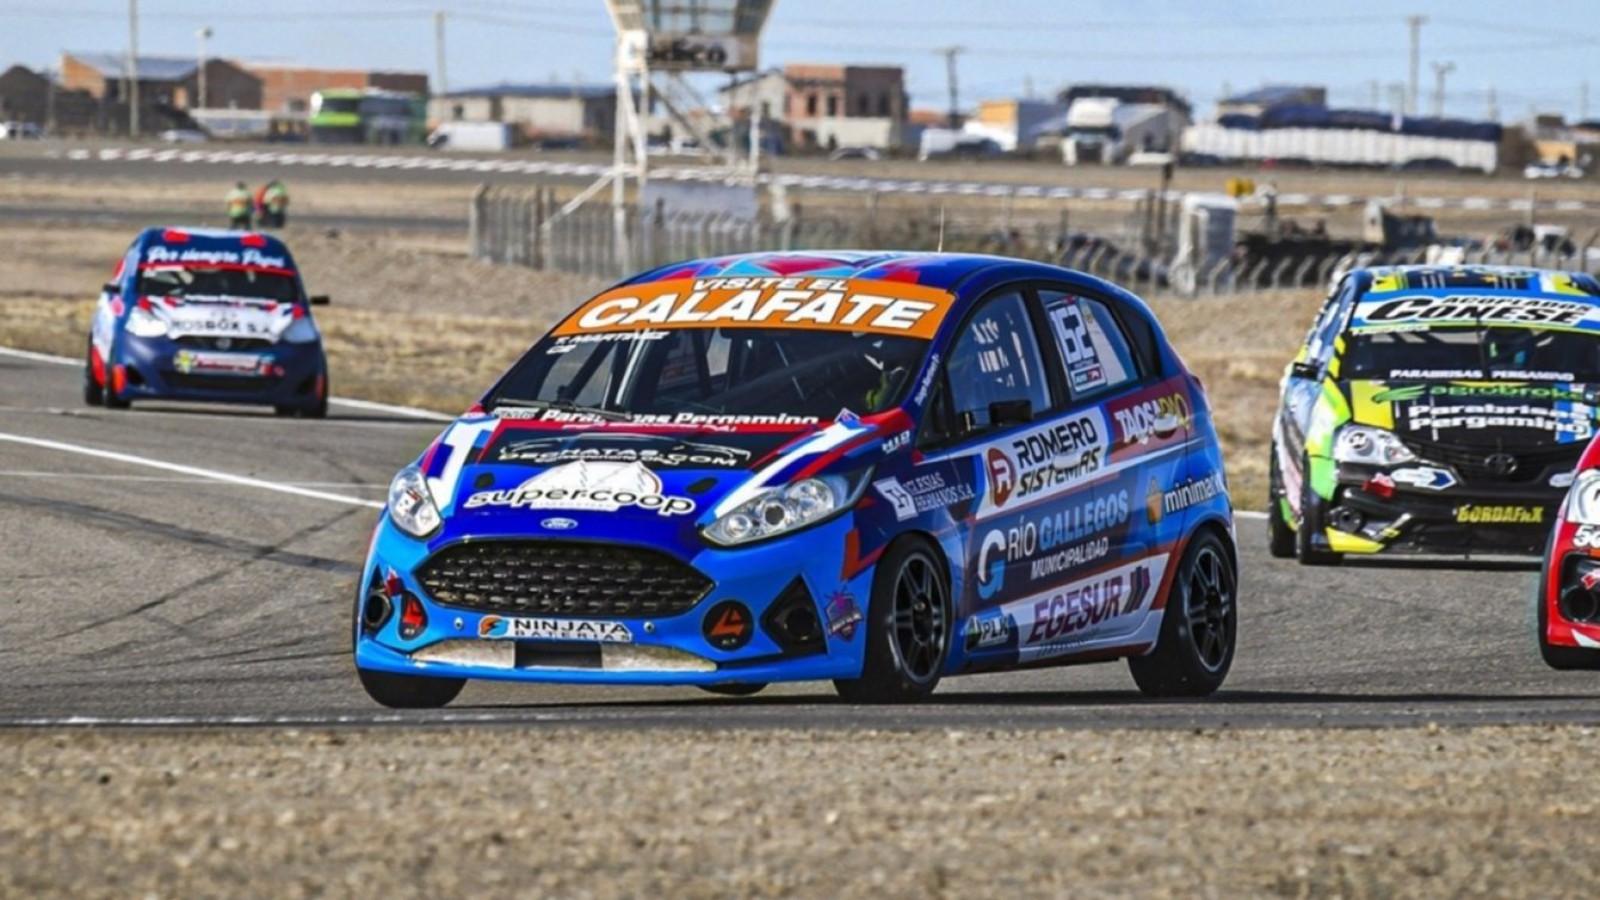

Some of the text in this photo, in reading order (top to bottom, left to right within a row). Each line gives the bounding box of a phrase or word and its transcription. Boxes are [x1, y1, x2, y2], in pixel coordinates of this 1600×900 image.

[694, 278, 849, 291] VISITE EL
[578, 289, 937, 329] CALAFATE
[1365, 298, 1582, 324] CONESE
[1390, 369, 1575, 381] PARABRISAS PERGAMINO
[673, 412, 819, 425] Pergamino
[1408, 403, 1589, 420] Parabrisas
[1409, 416, 1592, 438] Pergamino
[1012, 416, 1099, 468] ROMERO
[1016, 447, 1100, 498] SISTEMAS
[463, 488, 697, 516] supercoop
[1007, 490, 1130, 562] RÍO GALLEGOS
[1031, 536, 1109, 580] MUNICIPALIDAD
[1027, 575, 1124, 644] EGESUR
[514, 620, 630, 635] NINJATA
